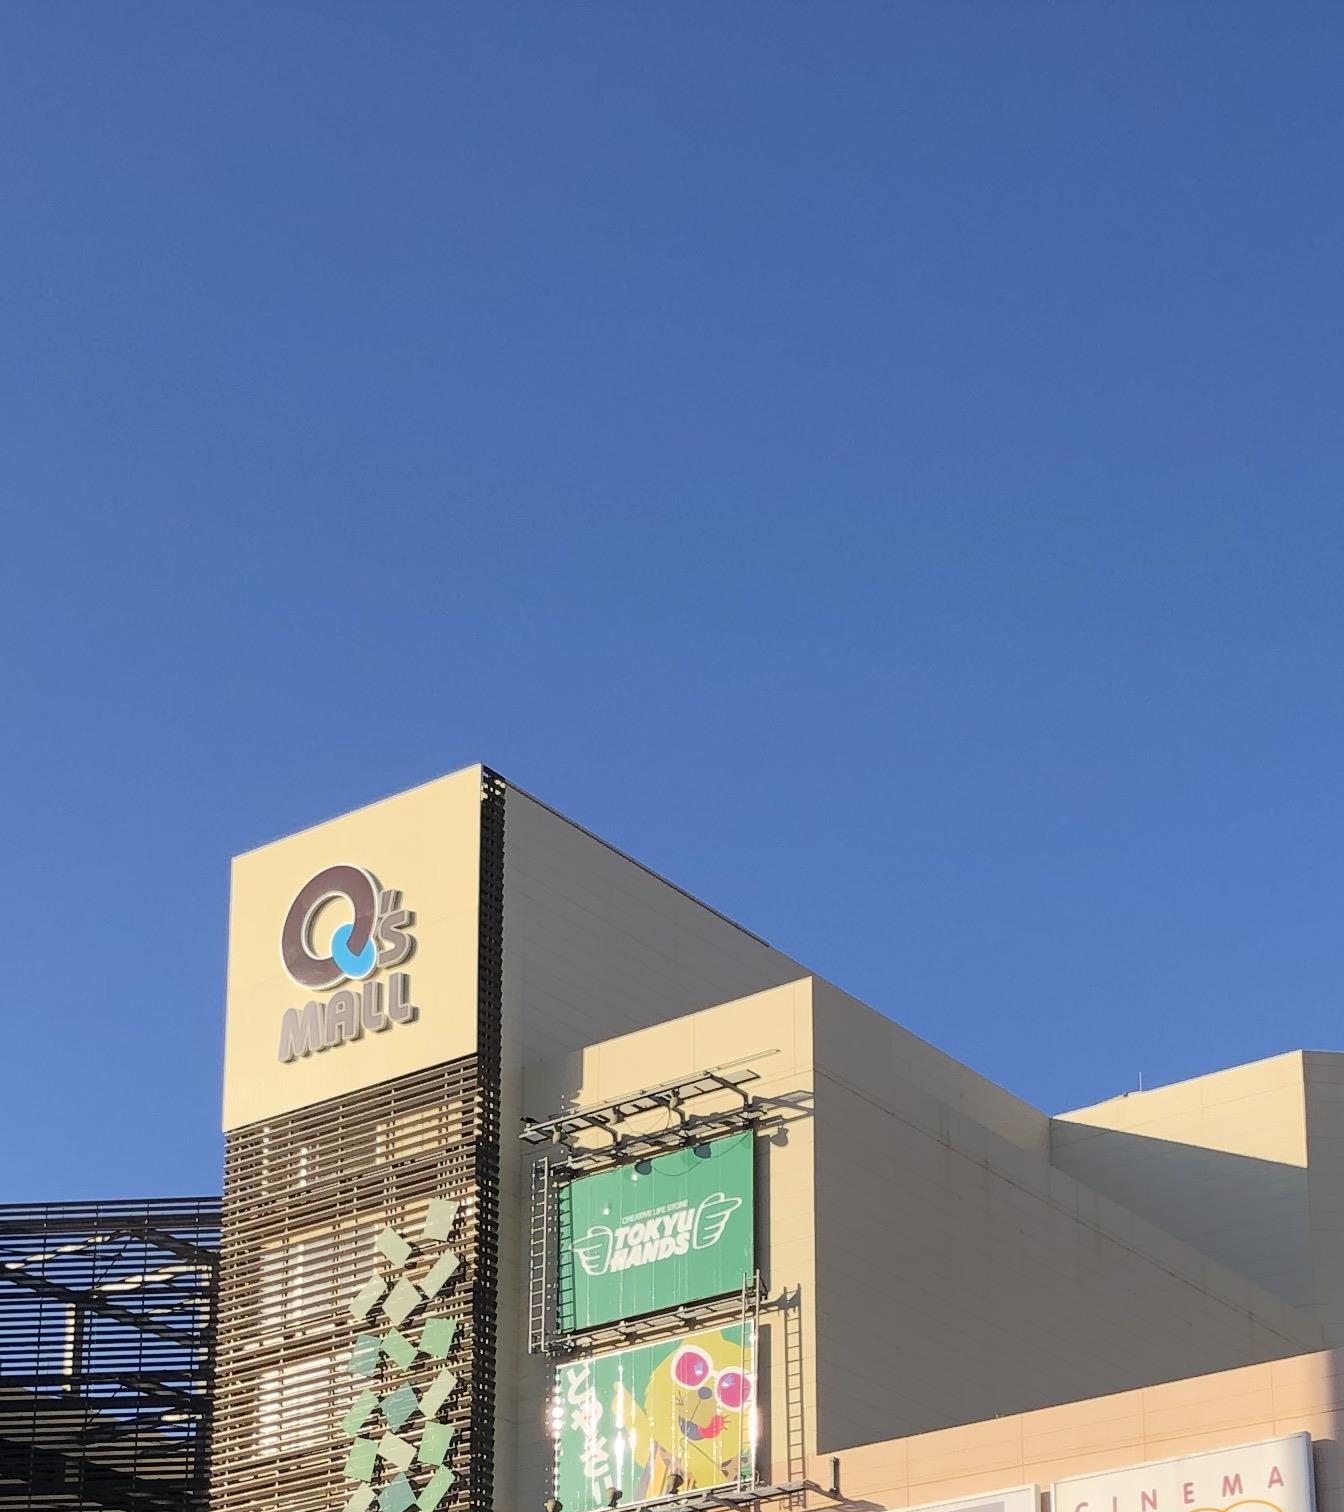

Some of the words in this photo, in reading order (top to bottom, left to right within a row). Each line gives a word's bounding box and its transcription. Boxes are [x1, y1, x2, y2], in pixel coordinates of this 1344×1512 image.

[281, 864, 417, 990] Q's
[278, 972, 420, 1063] MALL
[610, 1231, 691, 1272] HANDS
[614, 1208, 696, 1249] TOKYU
